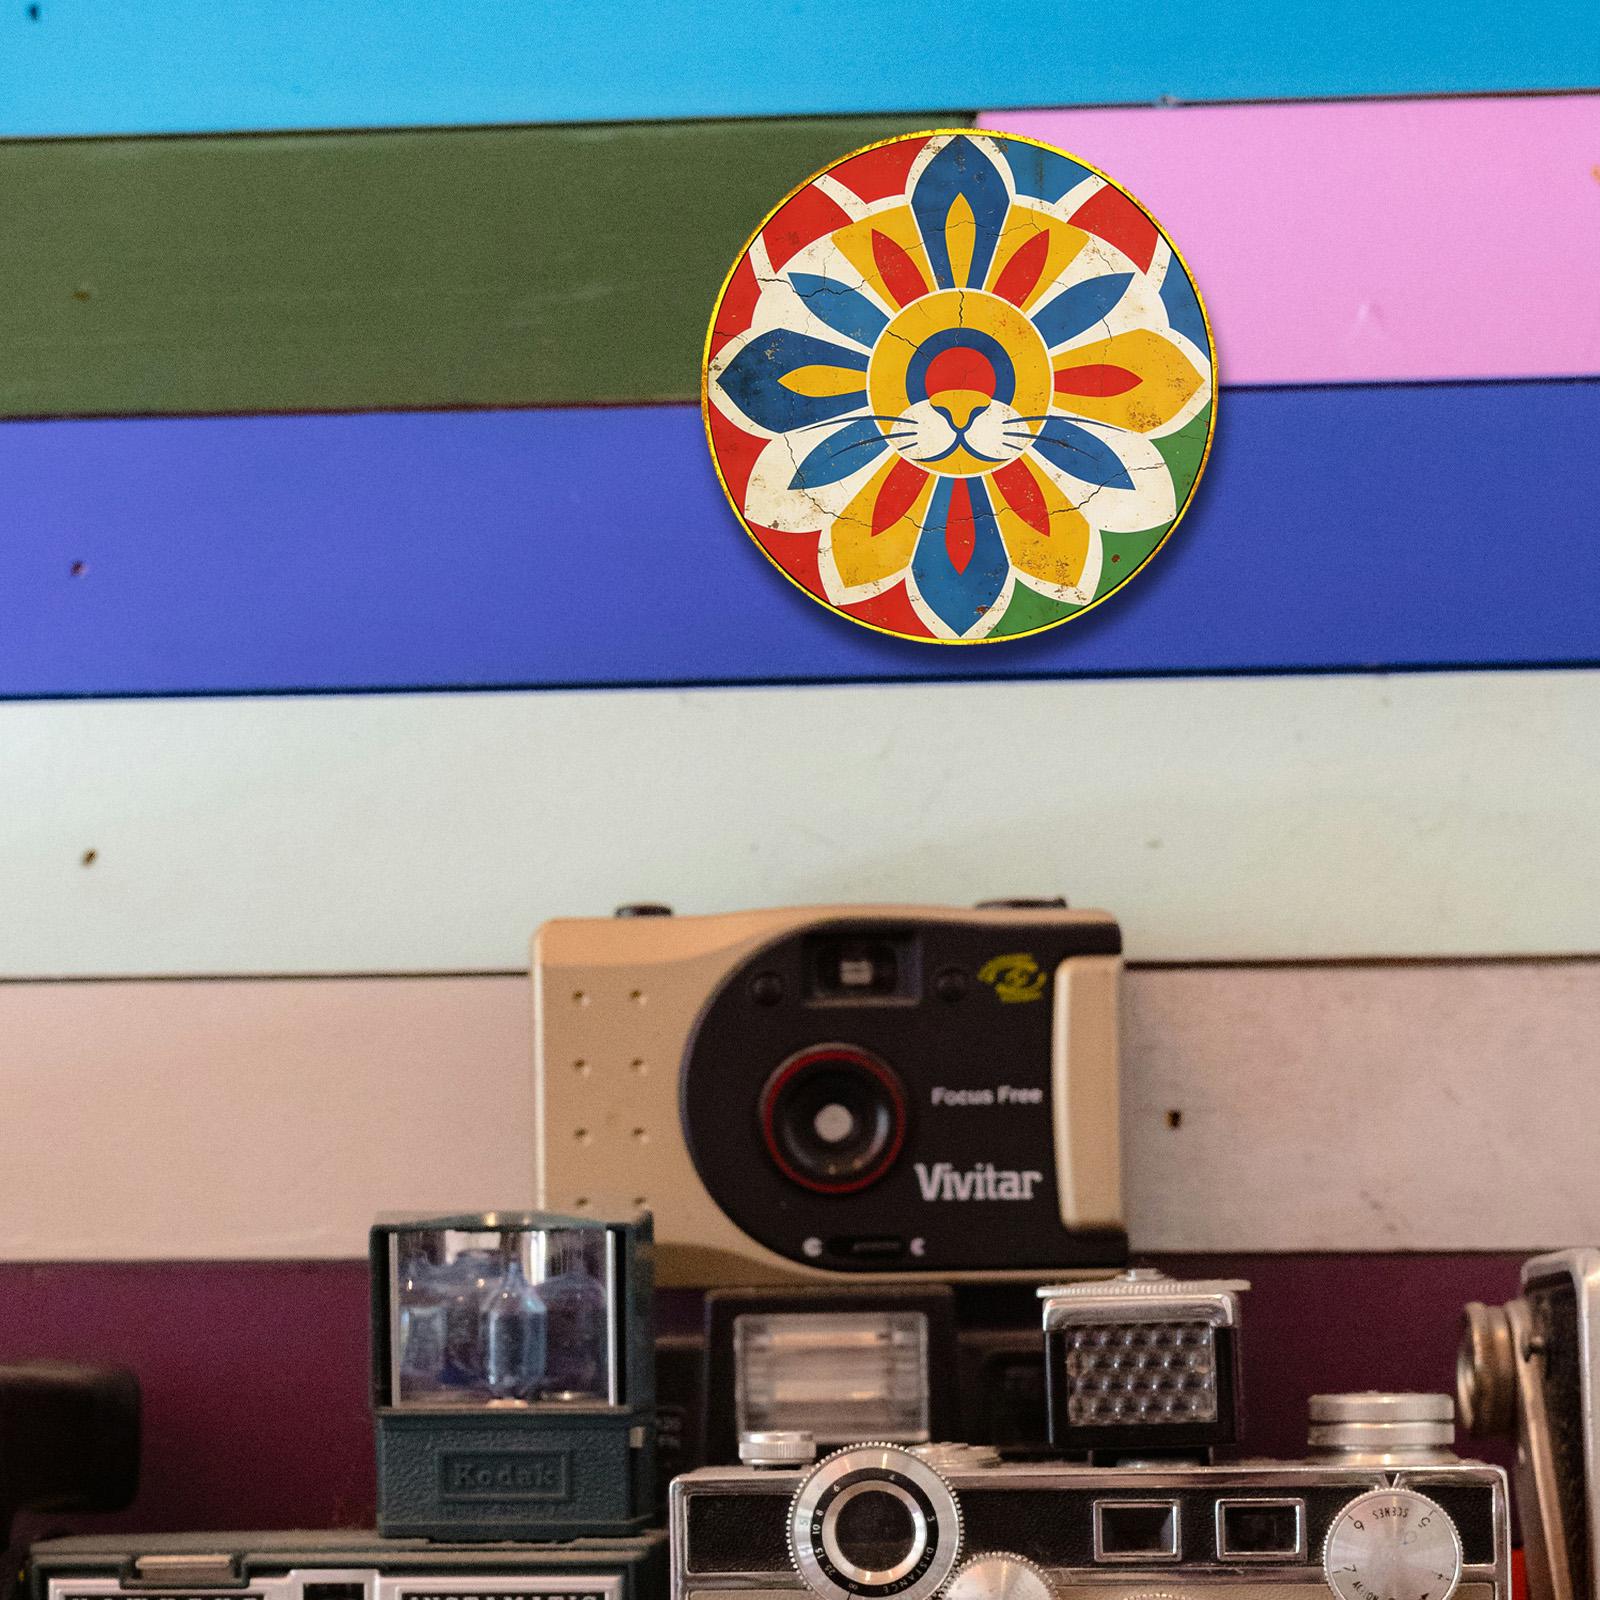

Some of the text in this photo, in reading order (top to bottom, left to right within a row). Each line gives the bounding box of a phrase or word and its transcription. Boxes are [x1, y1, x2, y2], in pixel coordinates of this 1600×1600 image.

[931, 1084, 1044, 1106] Focus Free
[913, 1162, 1044, 1201] Vivitar
[453, 1463, 558, 1487] Kodak
[815, 1508, 825, 1518] 8
[1372, 1507, 1410, 1520] SCENES
[811, 1523, 821, 1535] 10
[814, 1546, 825, 1560] 15
[883, 1546, 935, 1594] DISTANCE
